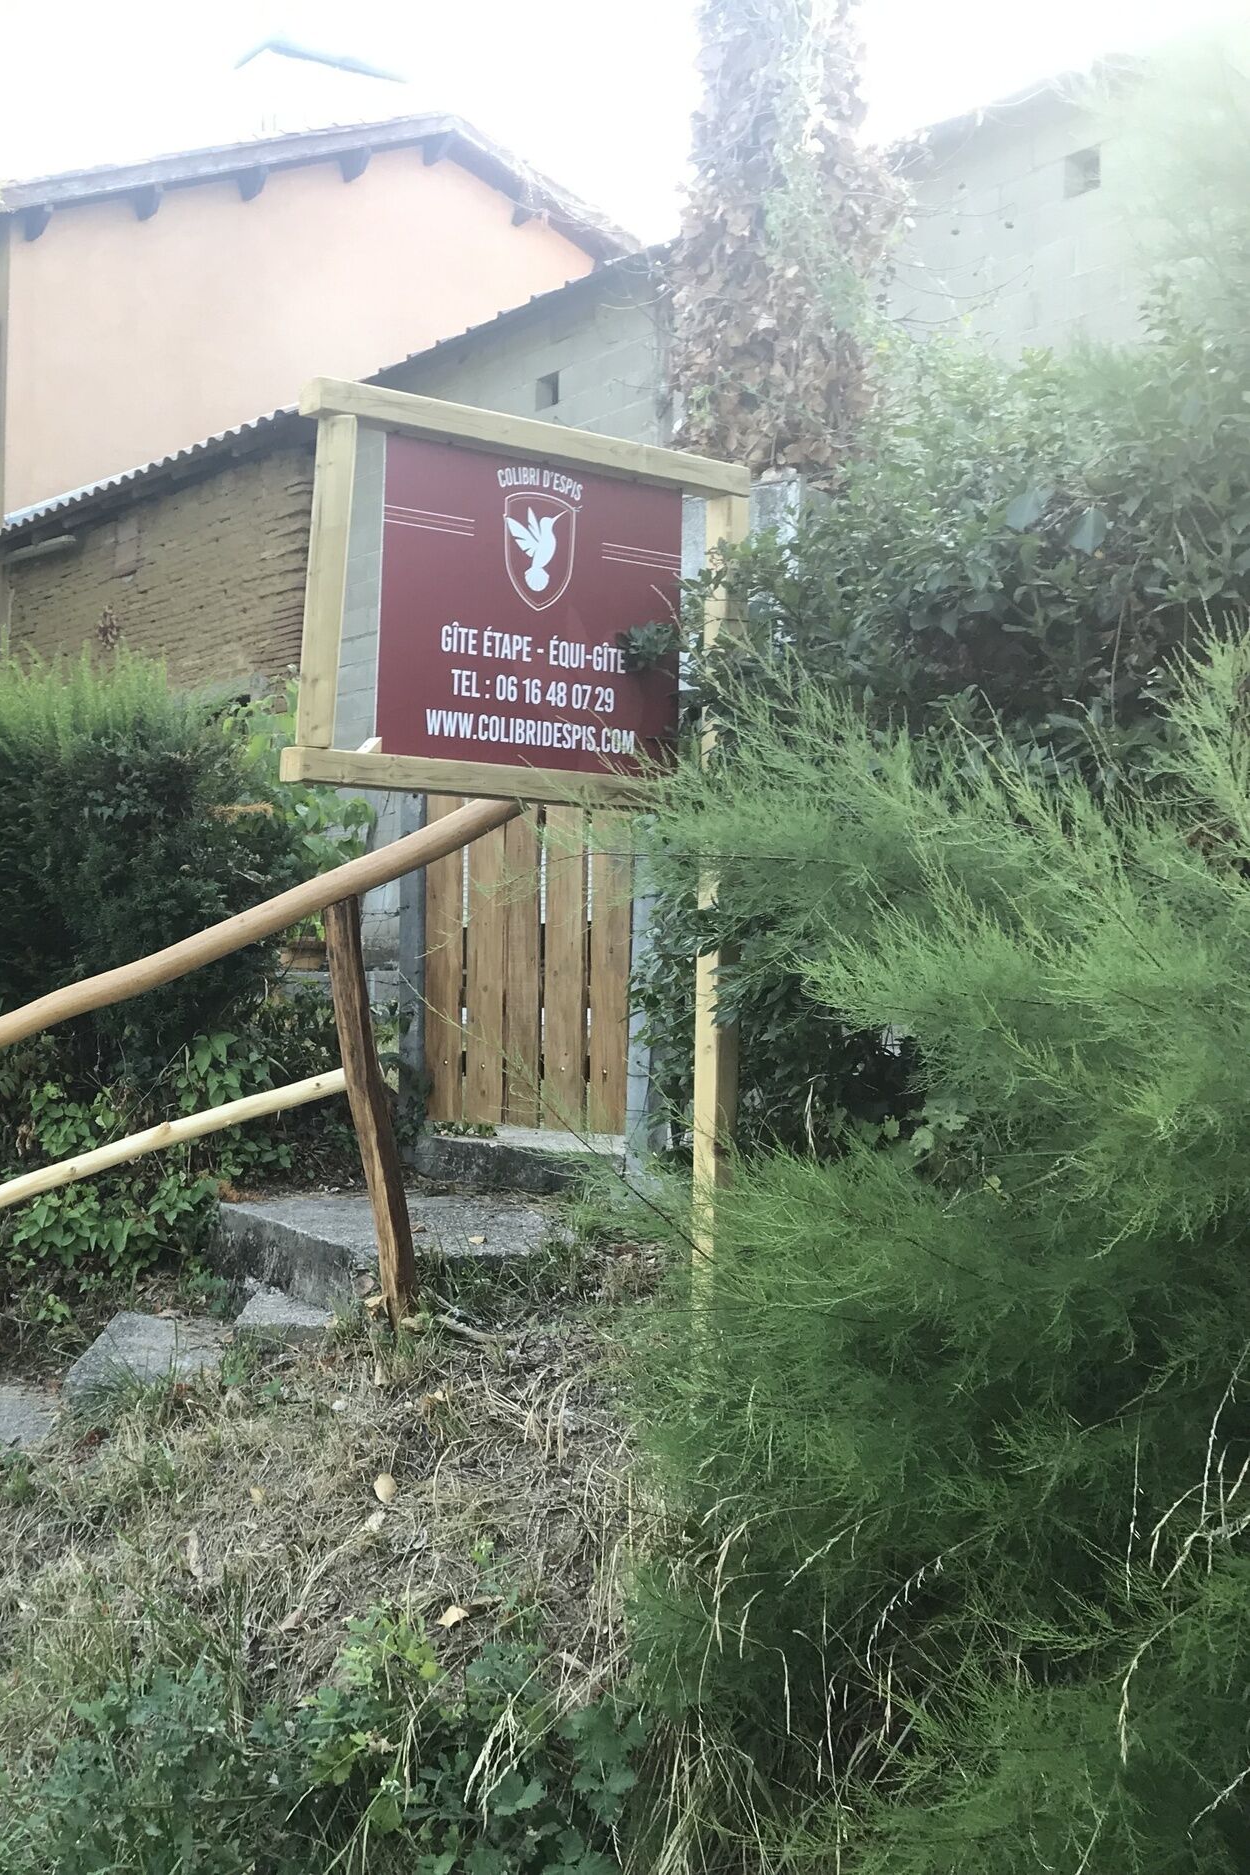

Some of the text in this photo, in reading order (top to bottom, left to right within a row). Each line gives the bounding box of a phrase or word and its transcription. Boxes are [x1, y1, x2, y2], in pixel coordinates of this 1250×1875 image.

[497, 466, 584, 501] COLIBRI D'ESPIS
[441, 621, 478, 656] GÎTE
[483, 626, 533, 662] ÉTAPE
[549, 635, 626, 674] ÉQUI-GÎTE
[451, 668, 480, 698] TEL
[495, 674, 518, 702] 06
[522, 678, 541, 705] 16
[546, 681, 567, 708] 48
[571, 683, 592, 710] 07
[595, 687, 615, 713] 29
[425, 708, 635, 755] WWW.COLIBRIDESPIS.COM
